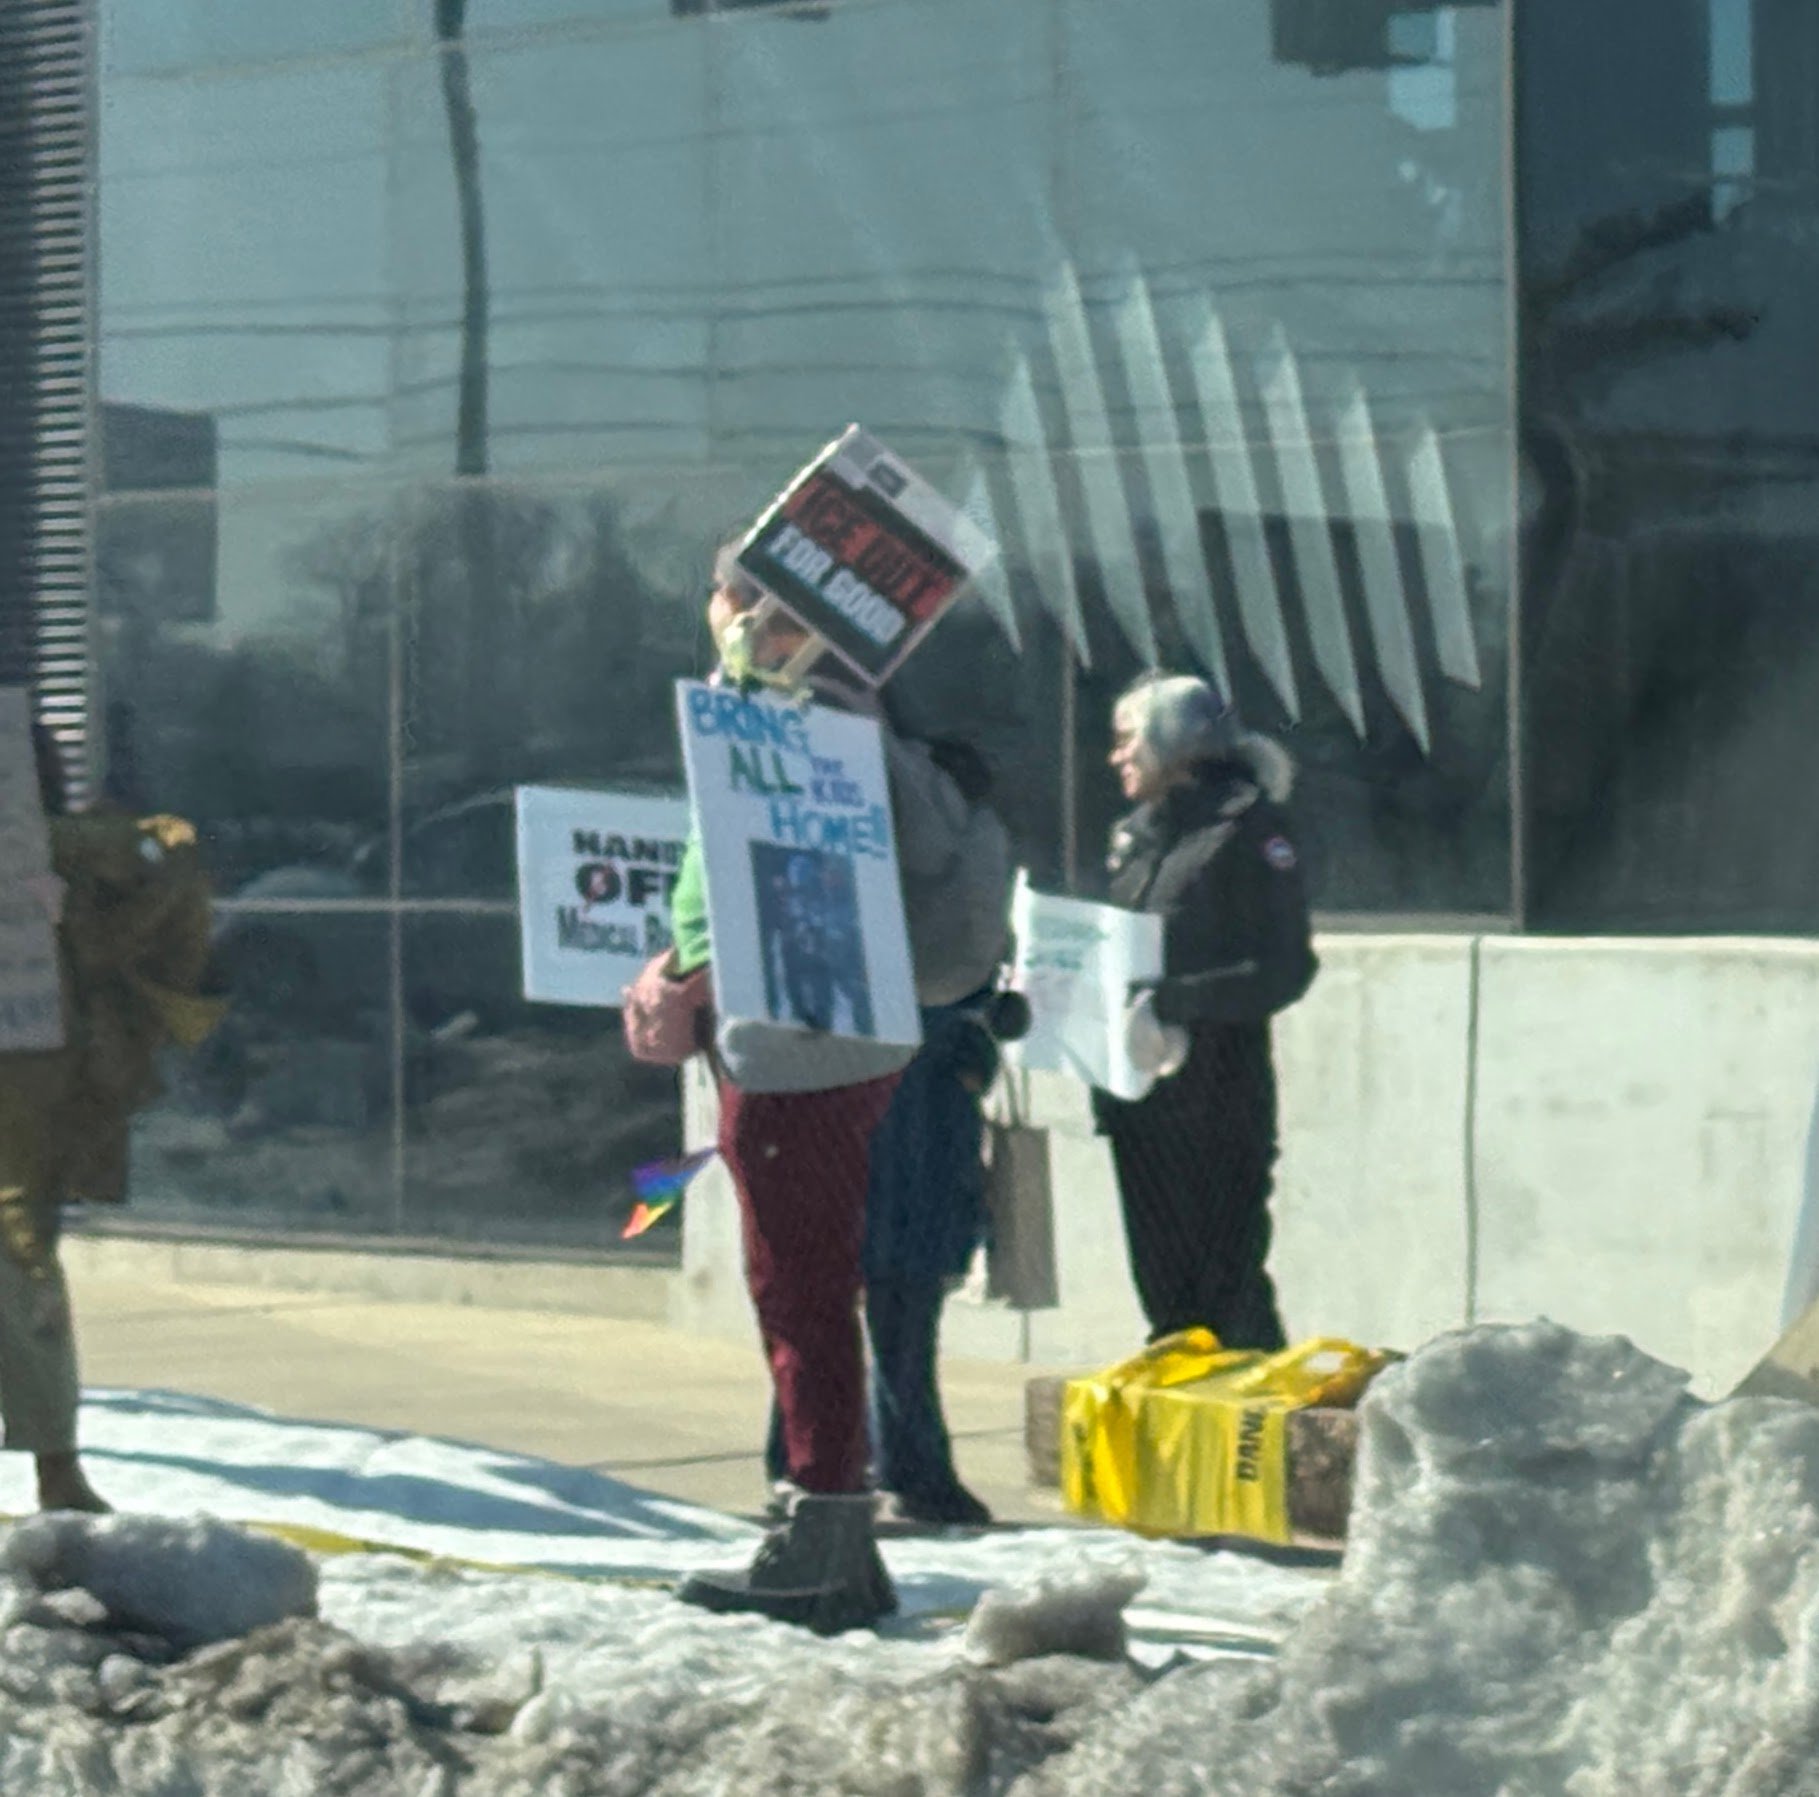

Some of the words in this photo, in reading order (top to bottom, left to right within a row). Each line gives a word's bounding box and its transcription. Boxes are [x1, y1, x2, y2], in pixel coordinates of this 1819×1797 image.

[764, 520, 836, 587] FOR
[818, 564, 910, 648] GOOD
[687, 688, 810, 754] BRING
[728, 743, 804, 794] ALL
[571, 828, 687, 865] HAND
